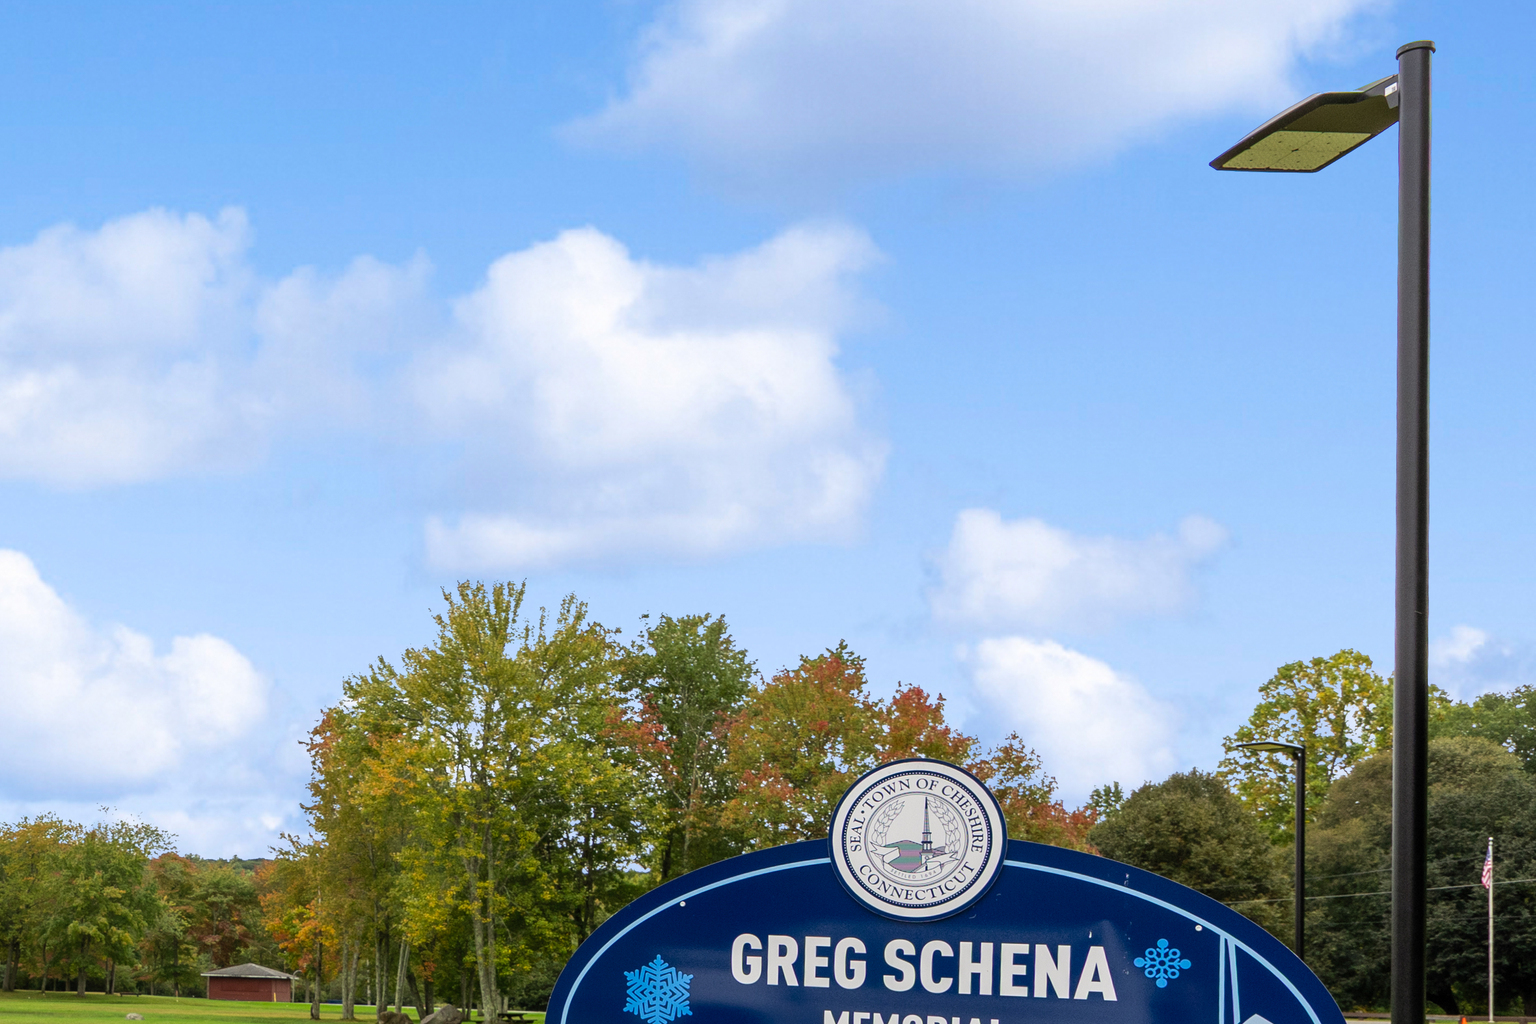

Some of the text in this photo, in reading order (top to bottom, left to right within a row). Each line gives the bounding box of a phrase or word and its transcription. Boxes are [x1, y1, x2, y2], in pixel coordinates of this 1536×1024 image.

[850, 778, 984, 853] SEAL TOWN OF CHESHIRE
[859, 861, 975, 901] CONNECTICUT
[731, 933, 1118, 1002] GREG SCHENA
